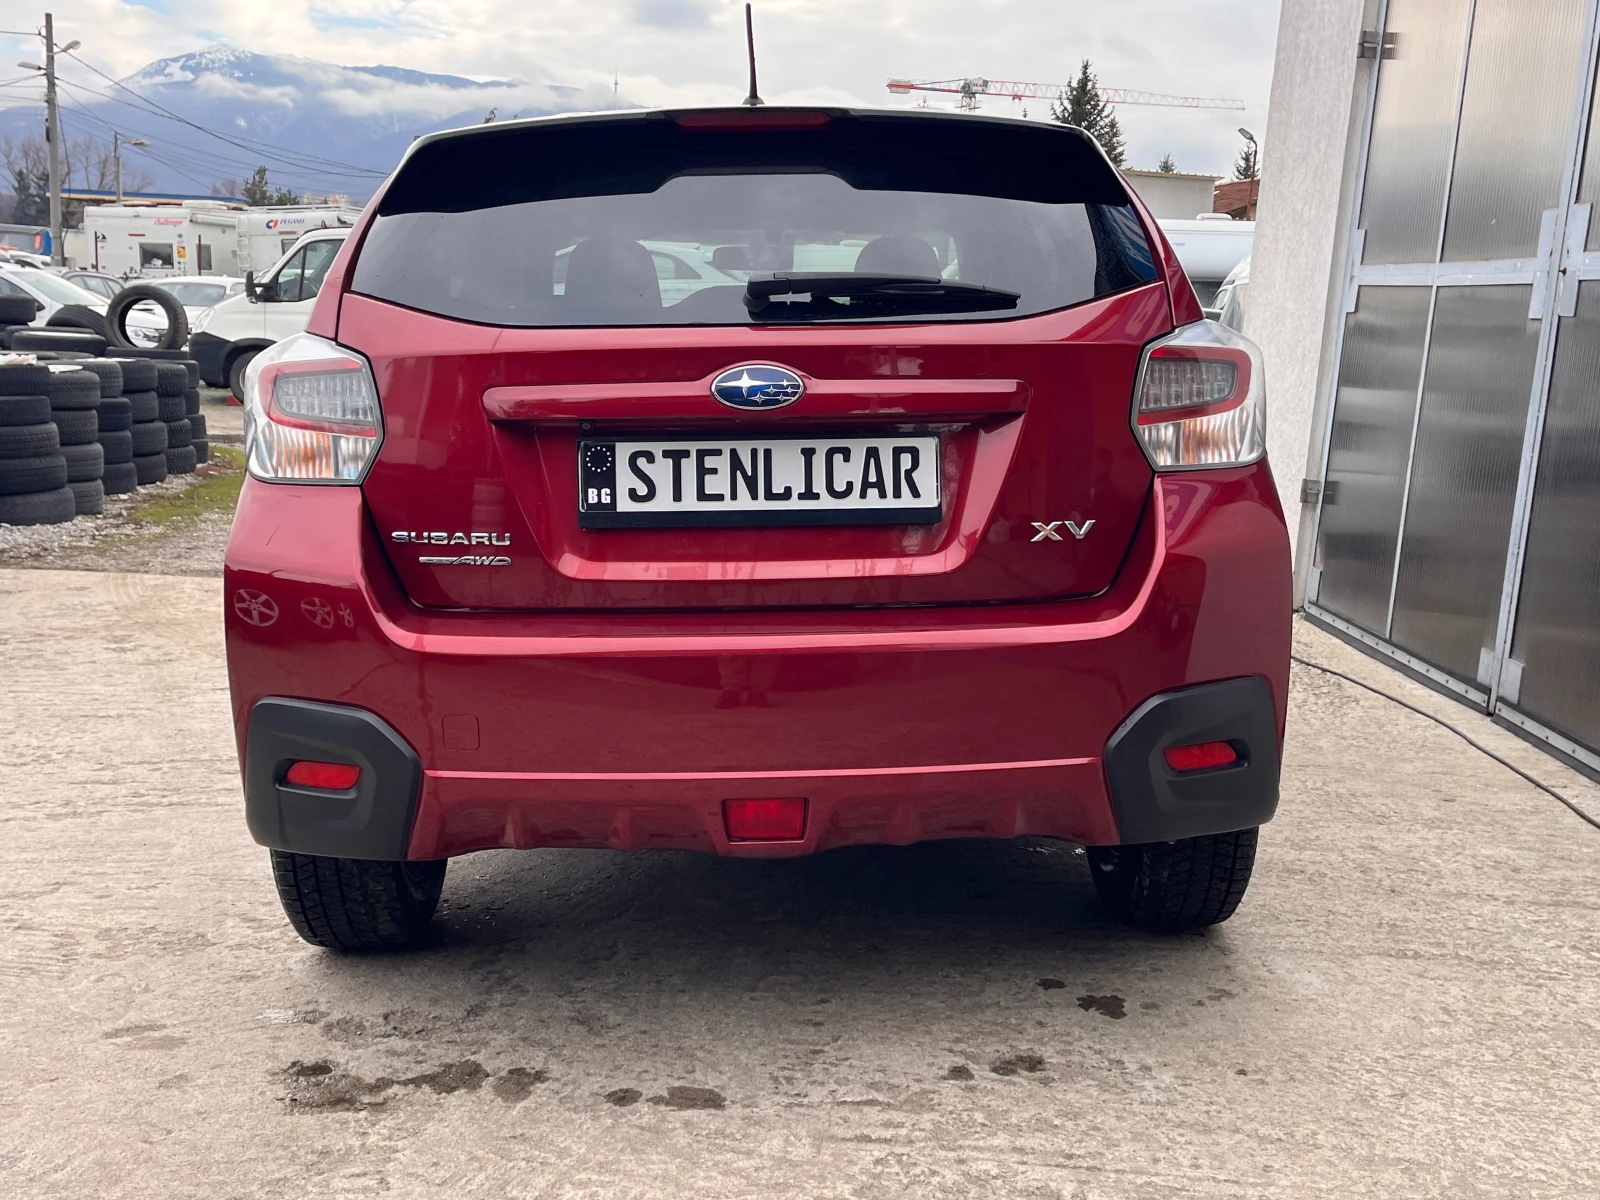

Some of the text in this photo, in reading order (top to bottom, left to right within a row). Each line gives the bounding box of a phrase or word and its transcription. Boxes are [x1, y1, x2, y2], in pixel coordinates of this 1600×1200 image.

[627, 446, 922, 503] STENLICAR
[587, 487, 611, 504] BG
[391, 531, 511, 546] SUBARU
[1030, 519, 1096, 542] XV
[452, 555, 512, 566] AWD
